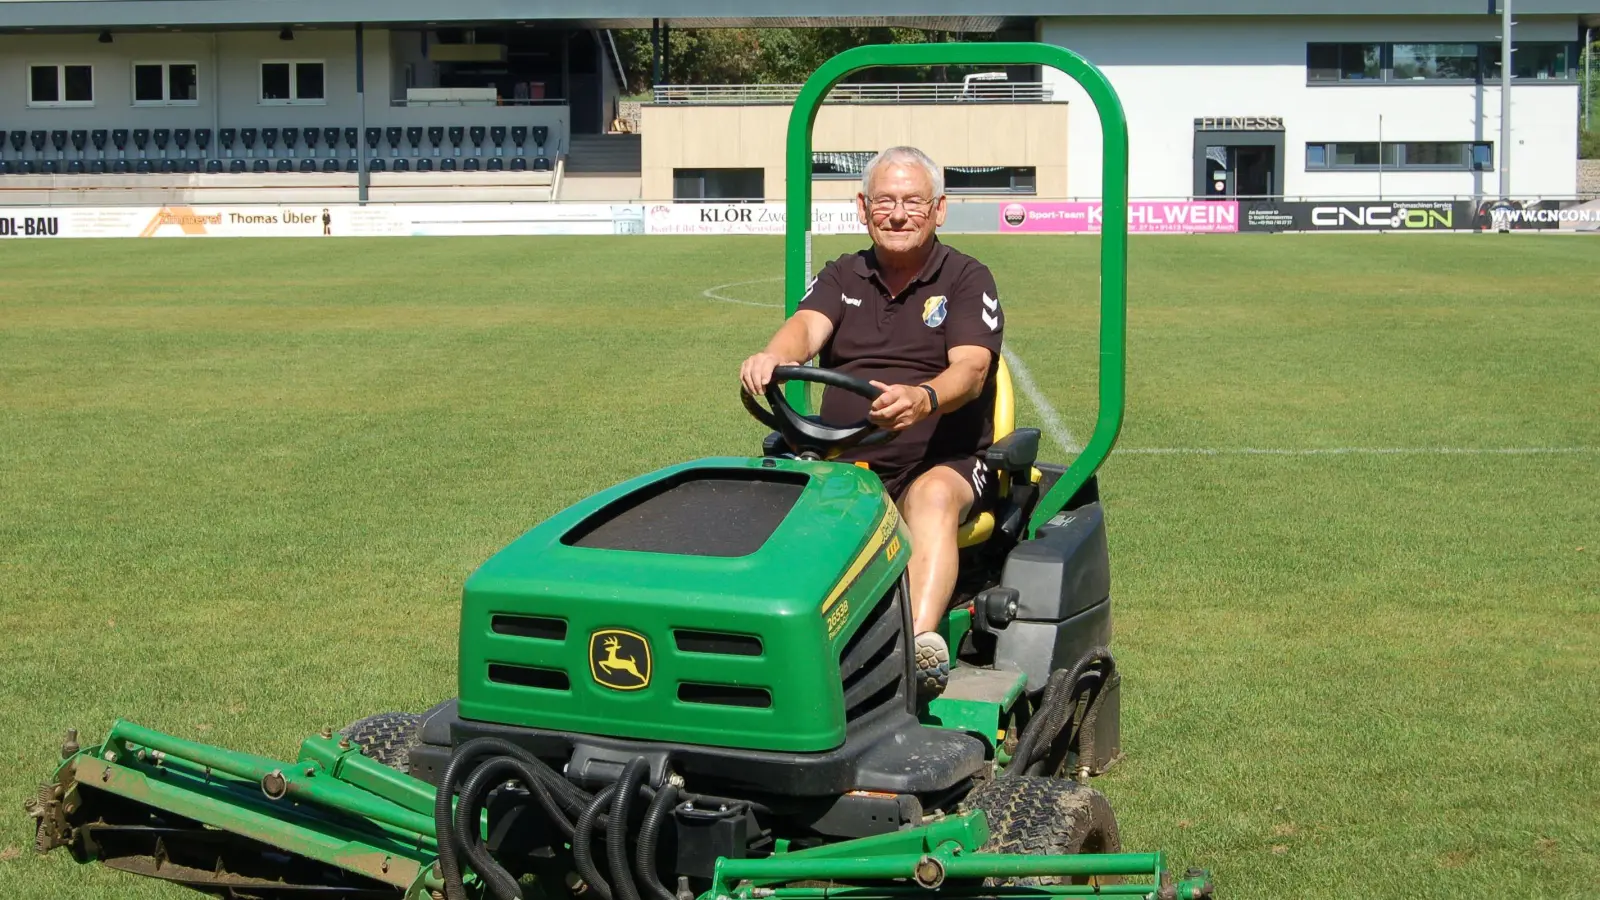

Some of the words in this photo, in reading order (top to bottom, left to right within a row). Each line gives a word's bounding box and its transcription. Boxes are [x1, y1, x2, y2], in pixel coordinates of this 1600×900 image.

[1203, 116, 1279, 130] FITNESS
[158, 213, 222, 225] Zimmerei
[229, 213, 278, 224] Thomas
[283, 210, 317, 224] Übler
[700, 204, 752, 222] KLÖR
[840, 212, 859, 223] un
[1028, 210, 1085, 221] Sport-Team
[1088, 205, 1235, 223] KHLWEIN
[1312, 206, 1392, 225] CNC
[1404, 210, 1453, 228] ON
[1491, 209, 1600, 222] WWW.CNCON.
[0, 217, 59, 236] DL-BAU
[827, 600, 849, 631] 2653B
